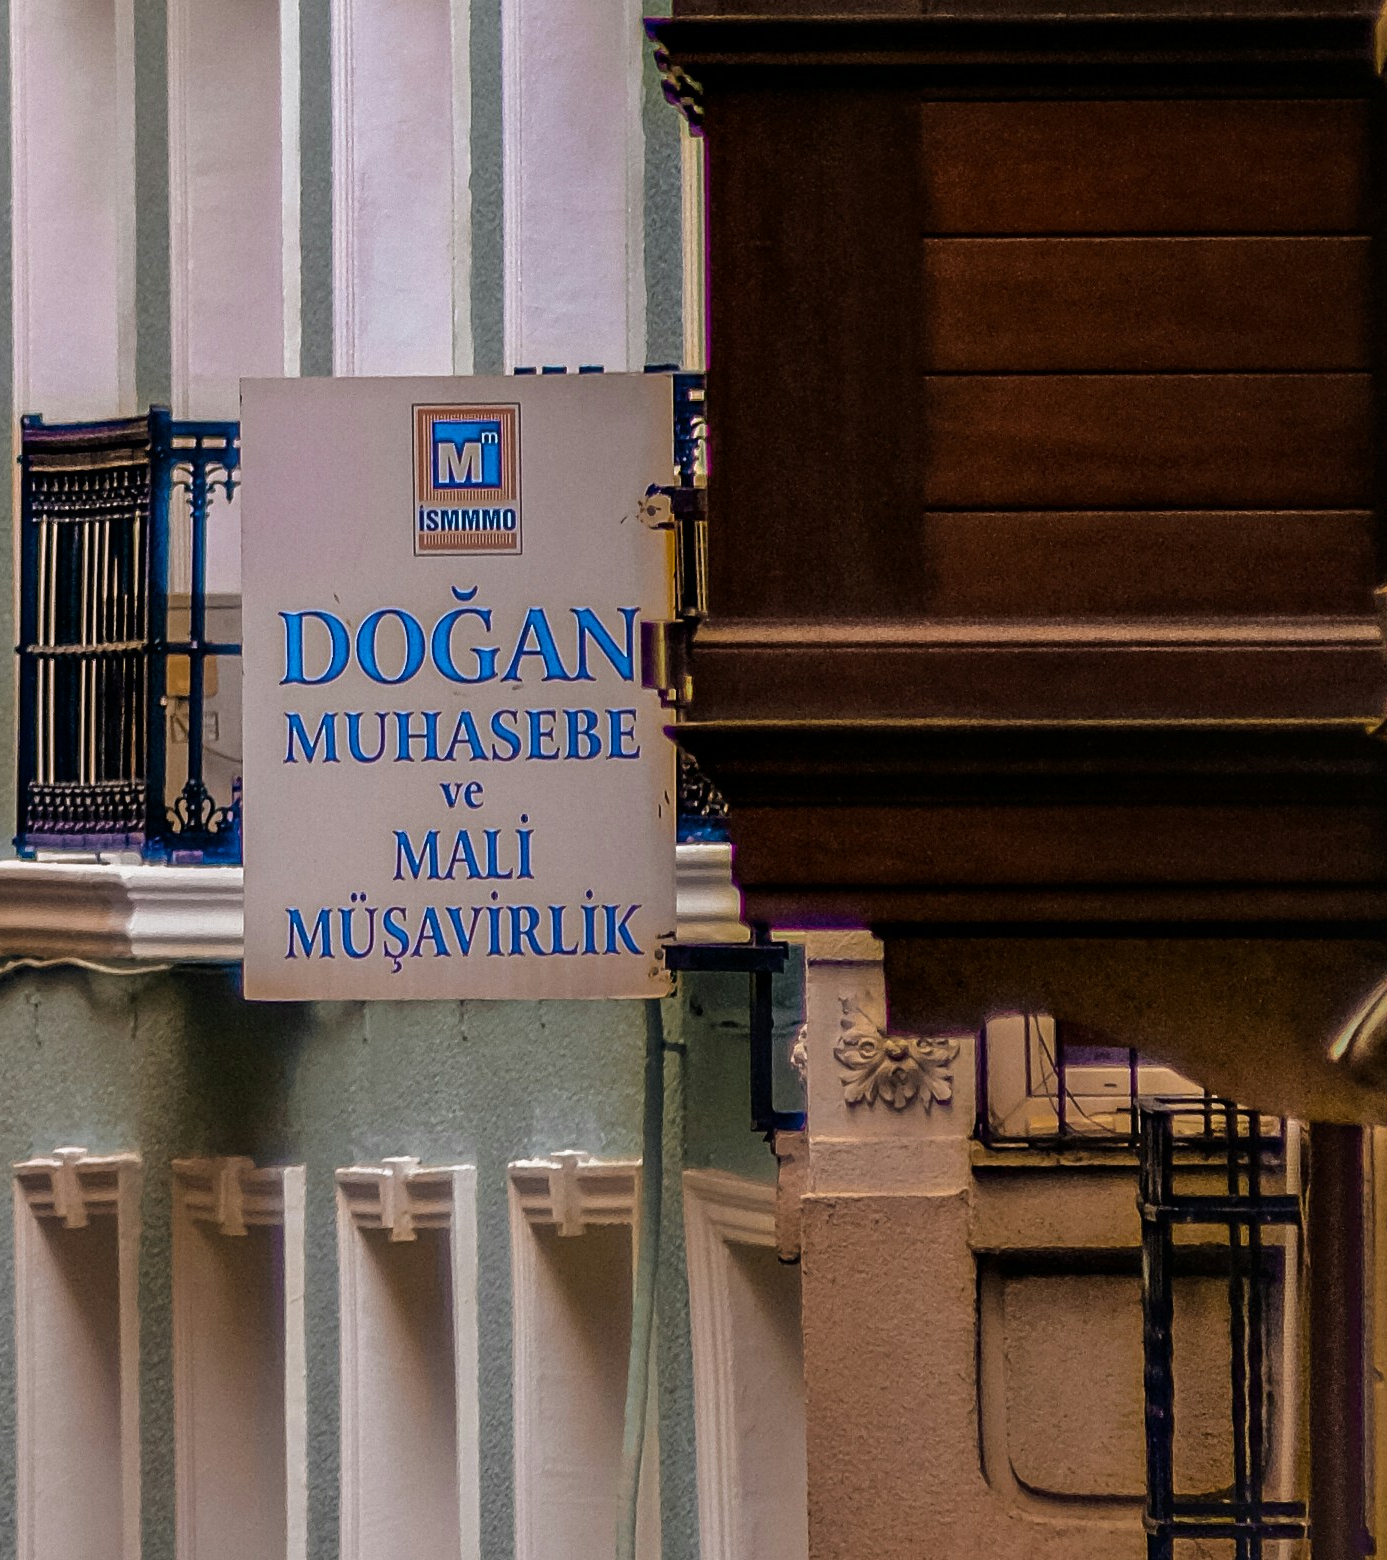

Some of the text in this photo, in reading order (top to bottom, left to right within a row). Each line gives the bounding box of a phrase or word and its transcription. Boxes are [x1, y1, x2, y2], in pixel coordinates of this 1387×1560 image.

[418, 504, 517, 533] İSMMMO
[278, 584, 642, 685] DOĞAN
[282, 708, 642, 764] MUHASEBE
[439, 781, 485, 810] ve
[392, 813, 535, 881] MALİ
[284, 888, 645, 972] MÜŞAVİRLİK
